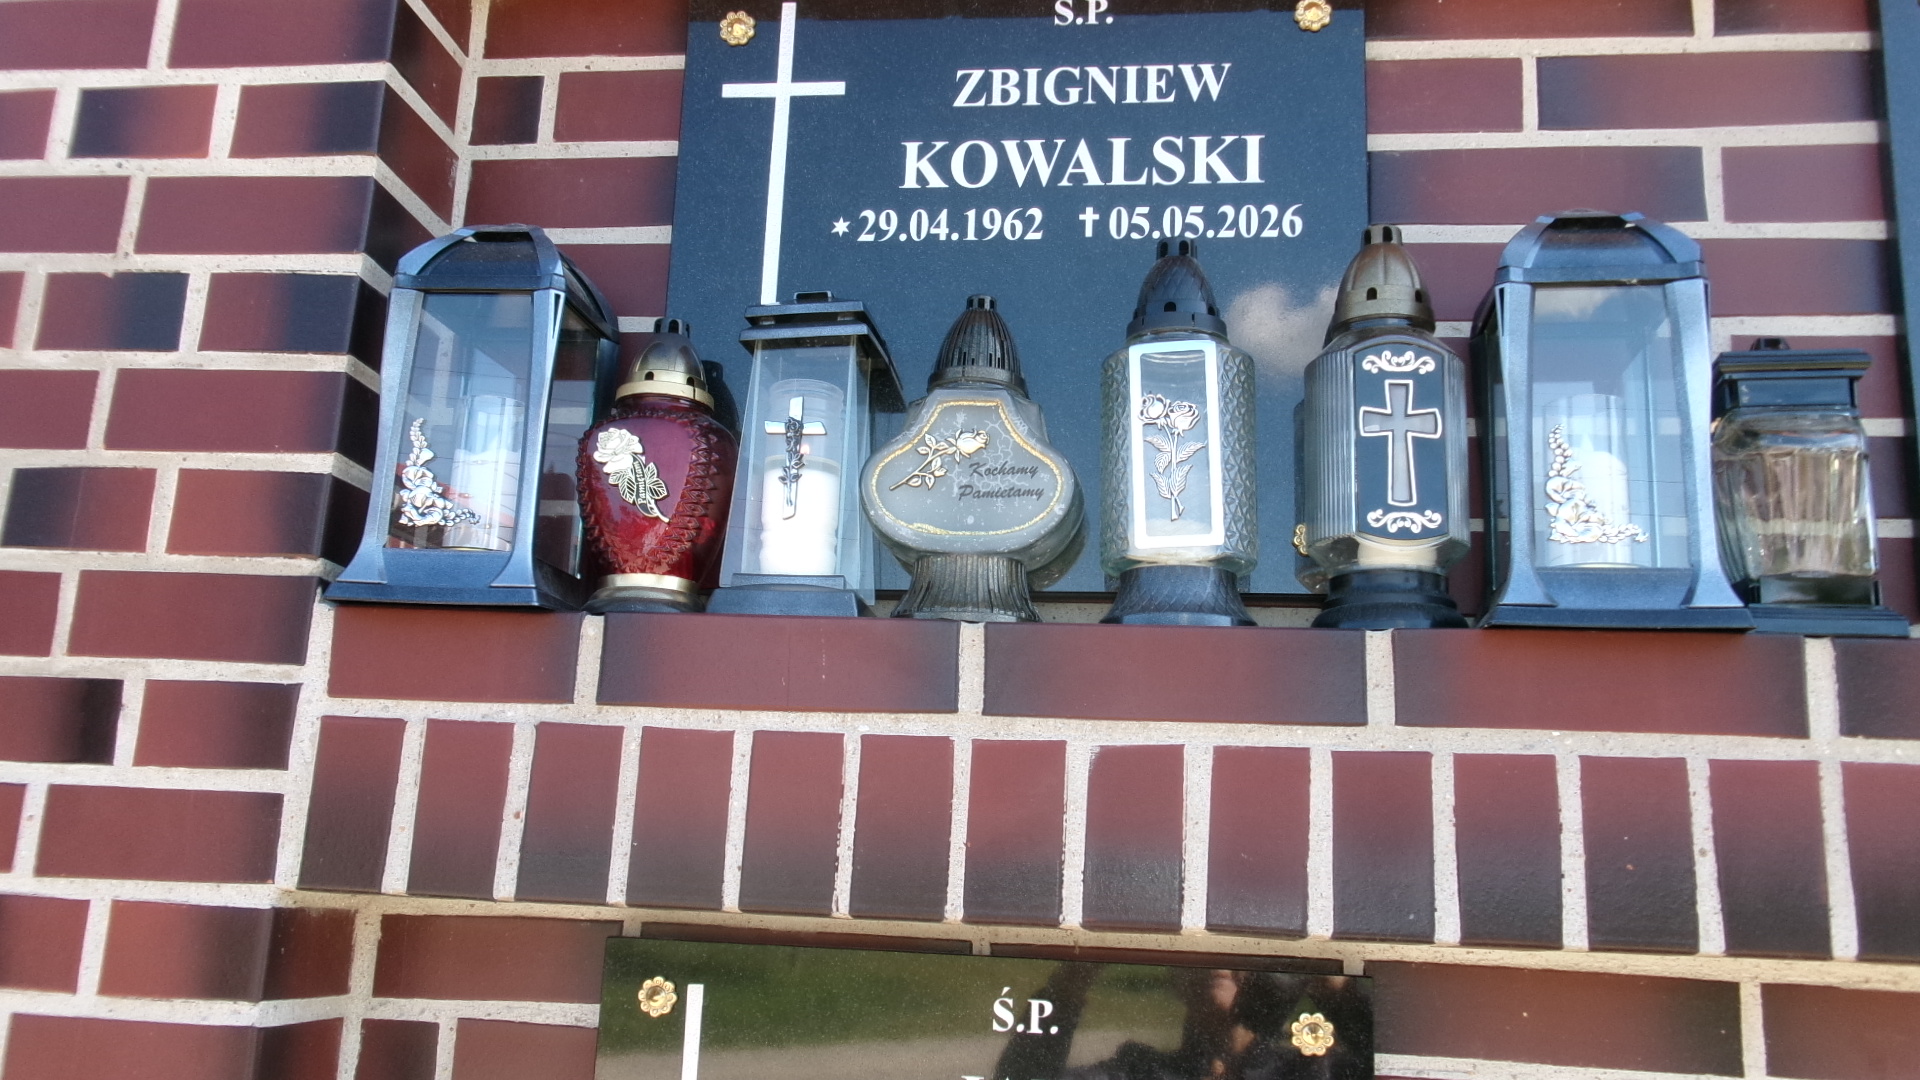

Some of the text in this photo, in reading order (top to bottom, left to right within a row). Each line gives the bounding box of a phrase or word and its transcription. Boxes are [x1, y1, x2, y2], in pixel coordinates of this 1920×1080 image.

[952, 63, 1231, 107] ZBIGNIEW
[899, 135, 1265, 188] KOWALSKI
[857, 203, 1304, 241] 29.04.1962 05.05.2026
[968, 461, 1039, 479] Kochamy
[992, 986, 1059, 1034] Ś.P.
